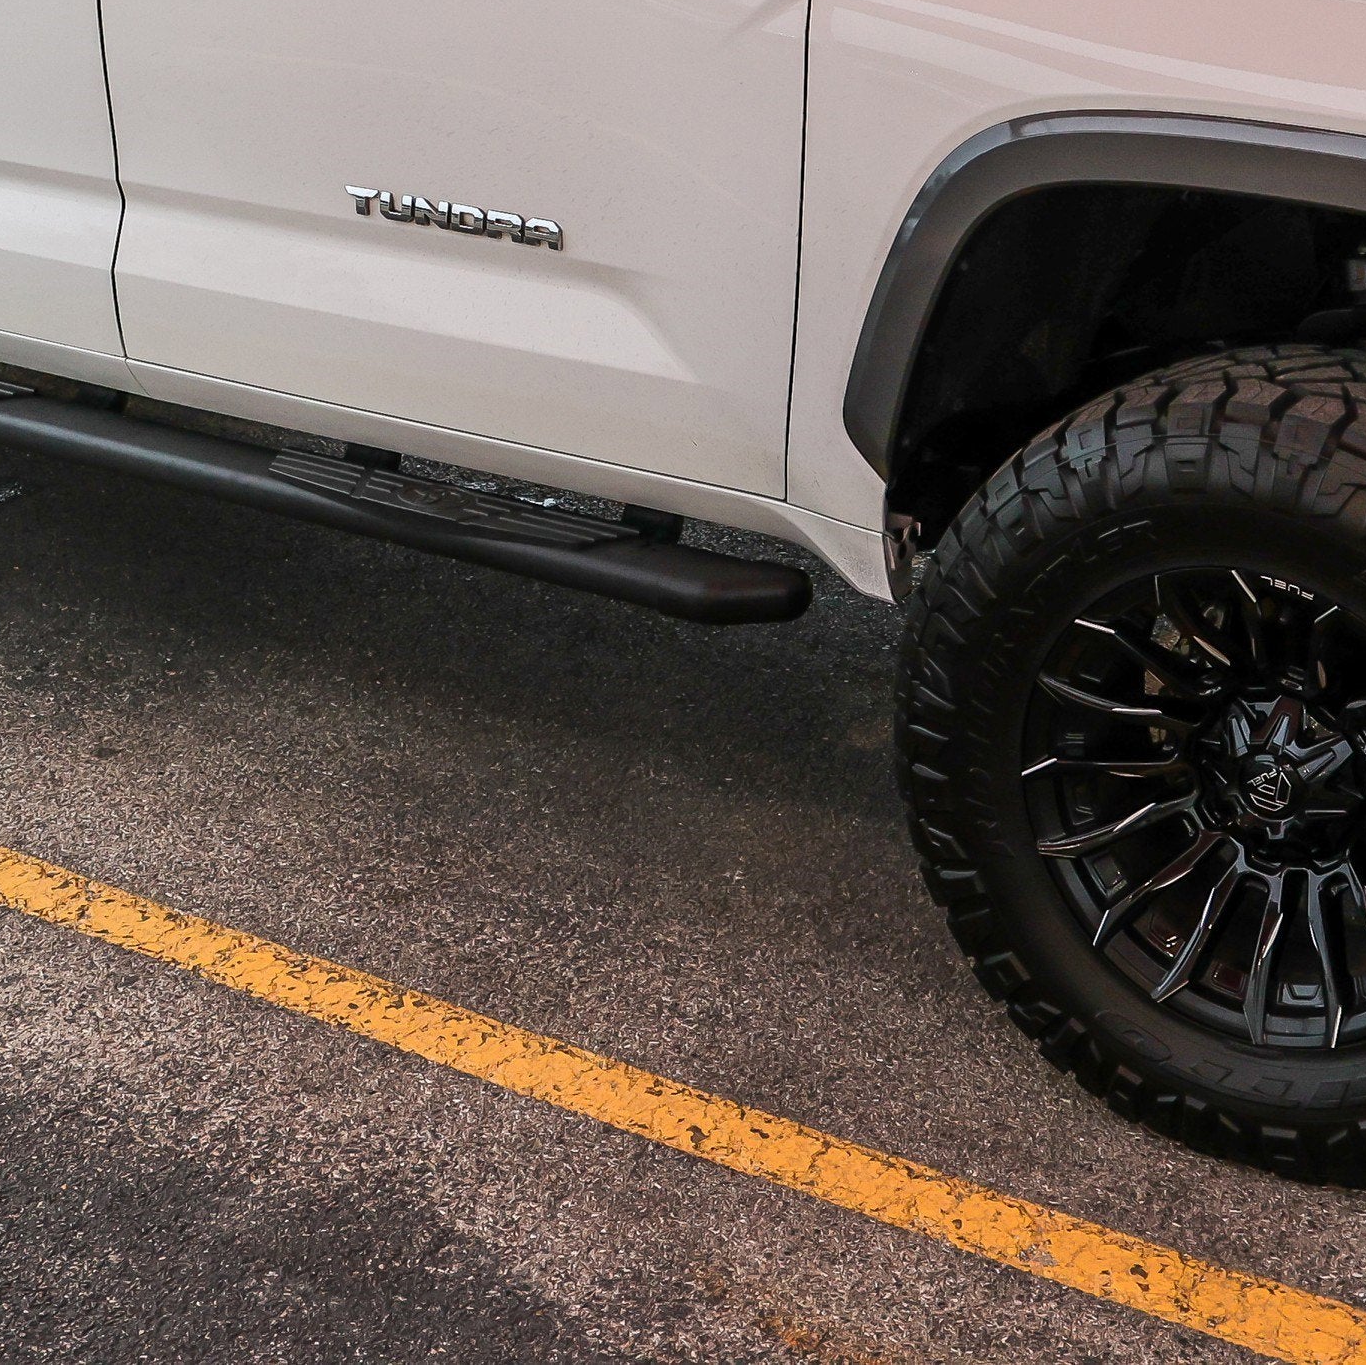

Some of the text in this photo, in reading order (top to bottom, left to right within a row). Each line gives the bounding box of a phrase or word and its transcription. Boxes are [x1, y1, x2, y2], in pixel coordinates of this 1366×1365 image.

[344, 184, 564, 252] TUNDRA
[1260, 575, 1315, 601] FUEL
[1247, 768, 1277, 787] FUEL
